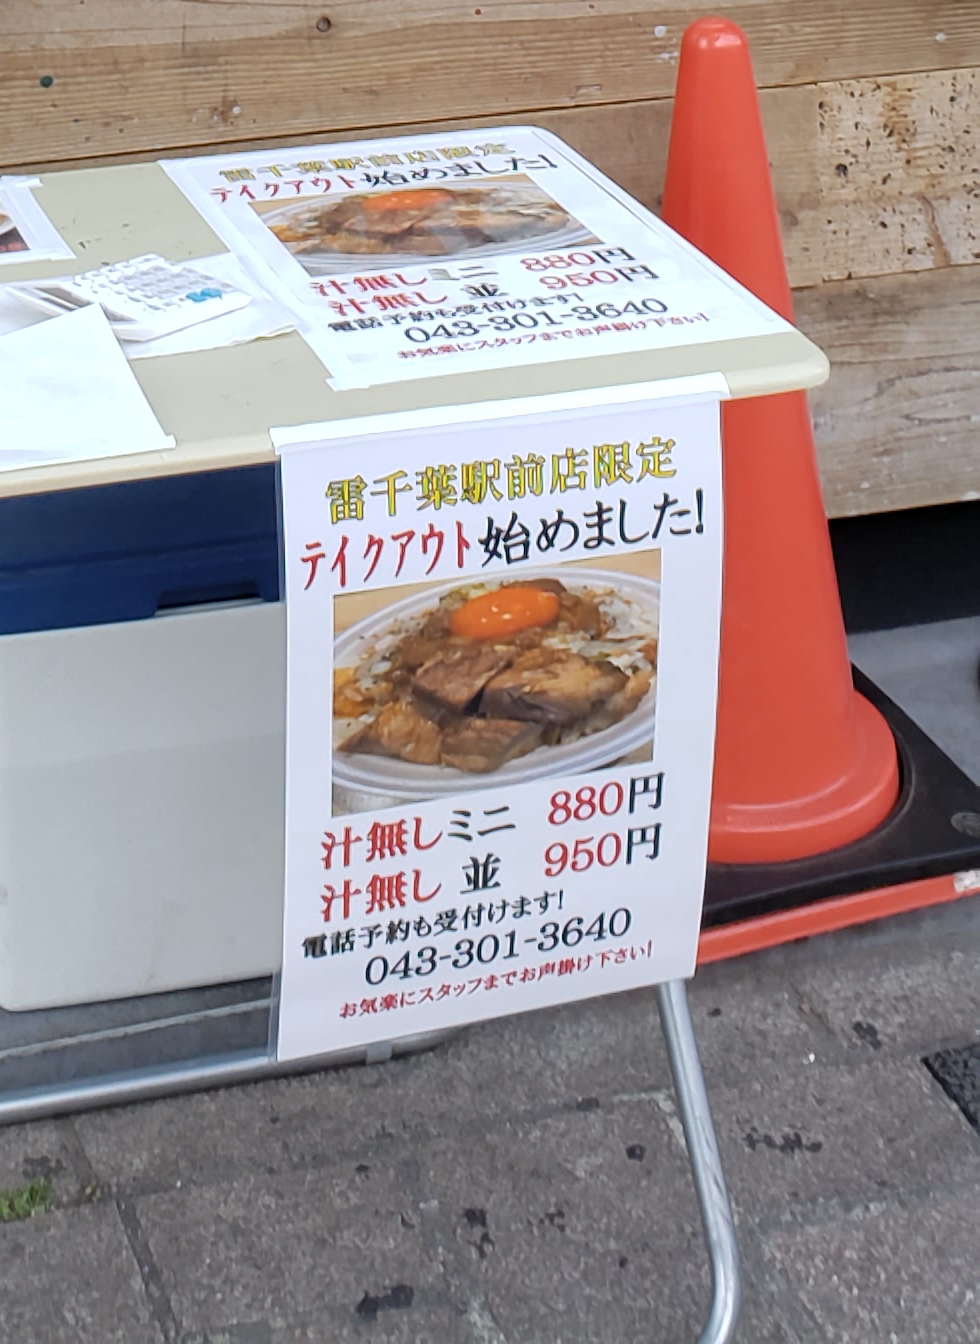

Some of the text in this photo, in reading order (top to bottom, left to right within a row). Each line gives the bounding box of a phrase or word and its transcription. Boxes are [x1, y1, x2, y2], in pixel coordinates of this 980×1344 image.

[327, 264, 660, 317] 汁無し 並 950円
[520, 247, 637, 272] 880円
[403, 298, 669, 343] 043-301-3640
[325, 436, 677, 525] 雷千葉駅前店限定
[300, 488, 704, 591] テイクアウト始めました!
[322, 771, 665, 869] 汁無しミニ 880円
[321, 823, 661, 922] 汁無し 並 950円
[301, 889, 564, 959] 電話予約も受付けます!
[365, 908, 631, 985] 043-301-3640
[339, 940, 653, 1019] お気楽にスタッフまでお声掛け下さい!
